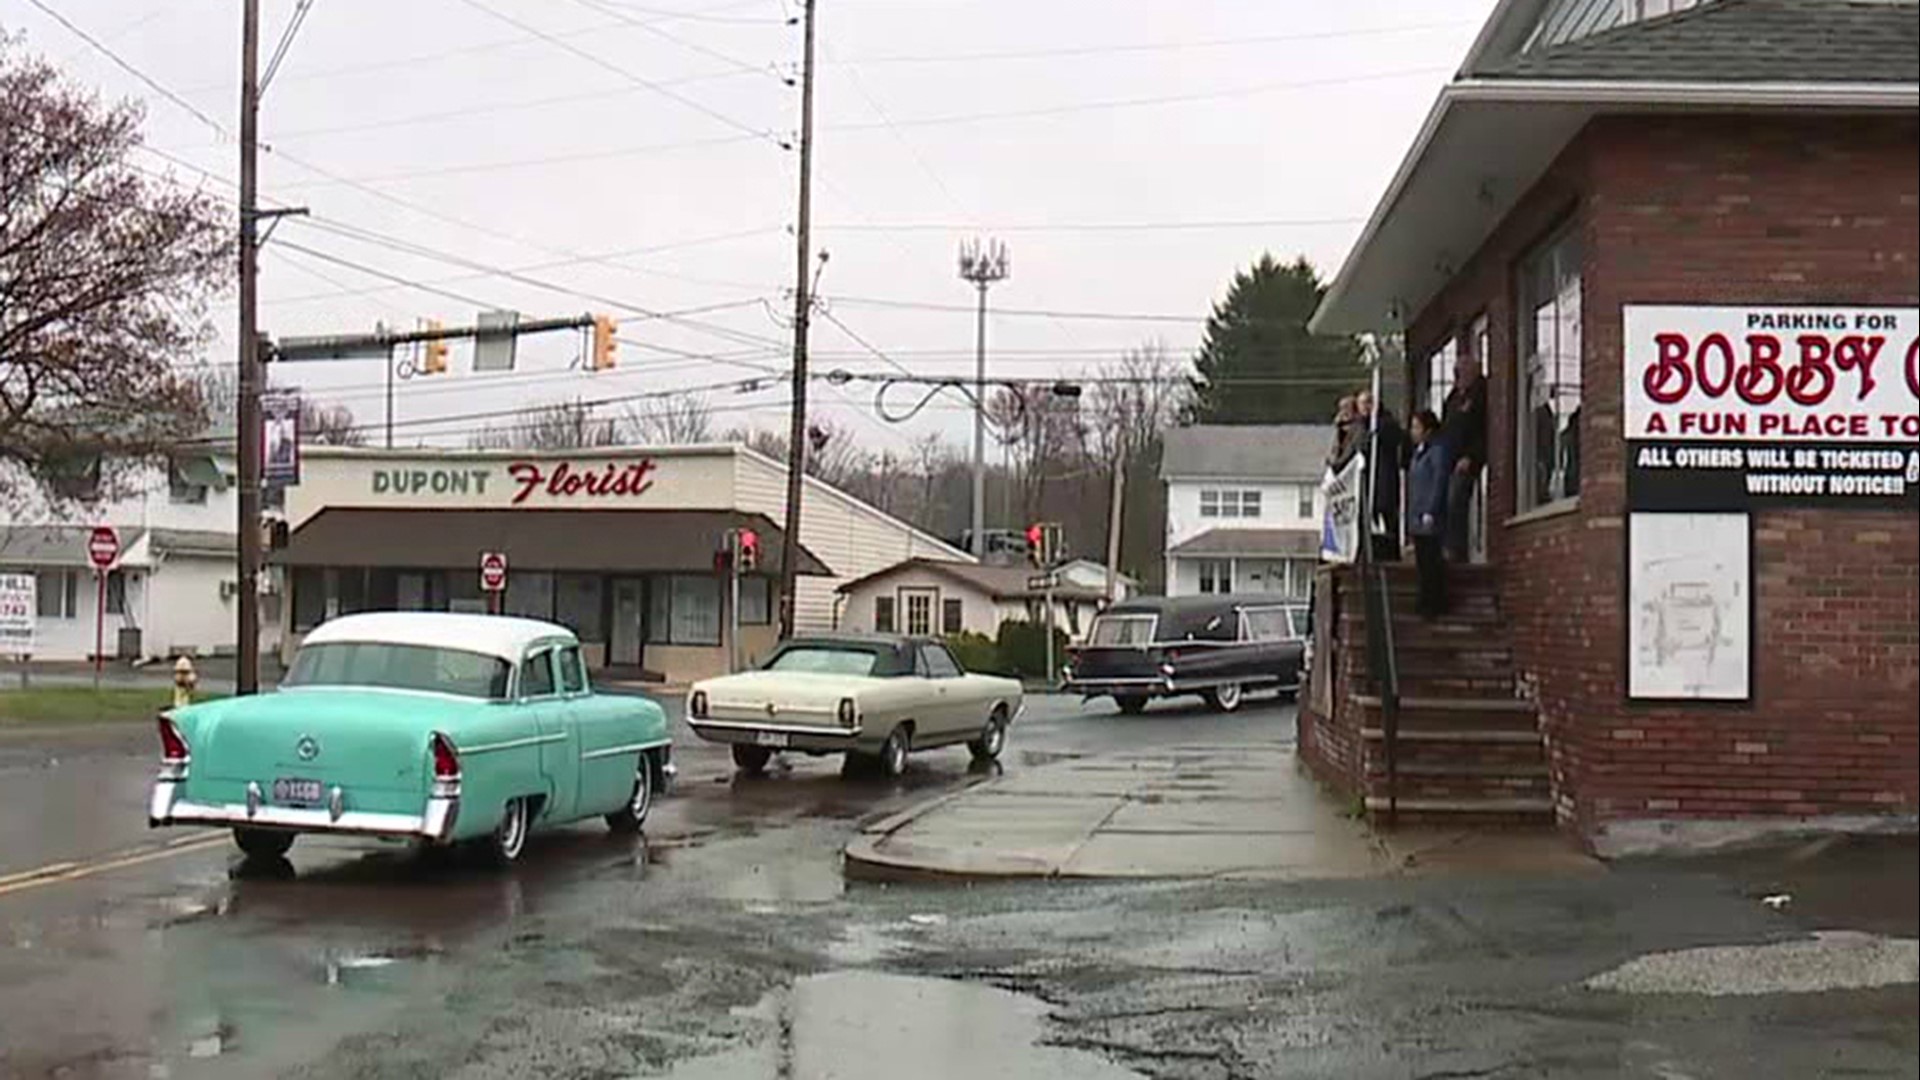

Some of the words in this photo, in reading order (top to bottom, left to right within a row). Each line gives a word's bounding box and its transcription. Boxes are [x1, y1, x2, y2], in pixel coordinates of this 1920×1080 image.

[1747, 314, 1847, 330] PARKING
[1855, 315, 1898, 330] FOR
[1643, 333, 1885, 406] BOBBY
[1646, 412, 1668, 434] A
[1680, 413, 1747, 435] FUN
[1759, 414, 1869, 436] PLACE
[1880, 415, 1919, 437] TO
[1637, 447, 1672, 467] ALL
[1675, 448, 1744, 468] OTHERS
[1746, 449, 1790, 469] WILL
[1794, 450, 1817, 469] BE
[1820, 450, 1904, 470] TICKETED
[372, 469, 491, 494] DUPONT
[507, 457, 657, 504] Florist
[1746, 474, 1826, 494] WITHOUT
